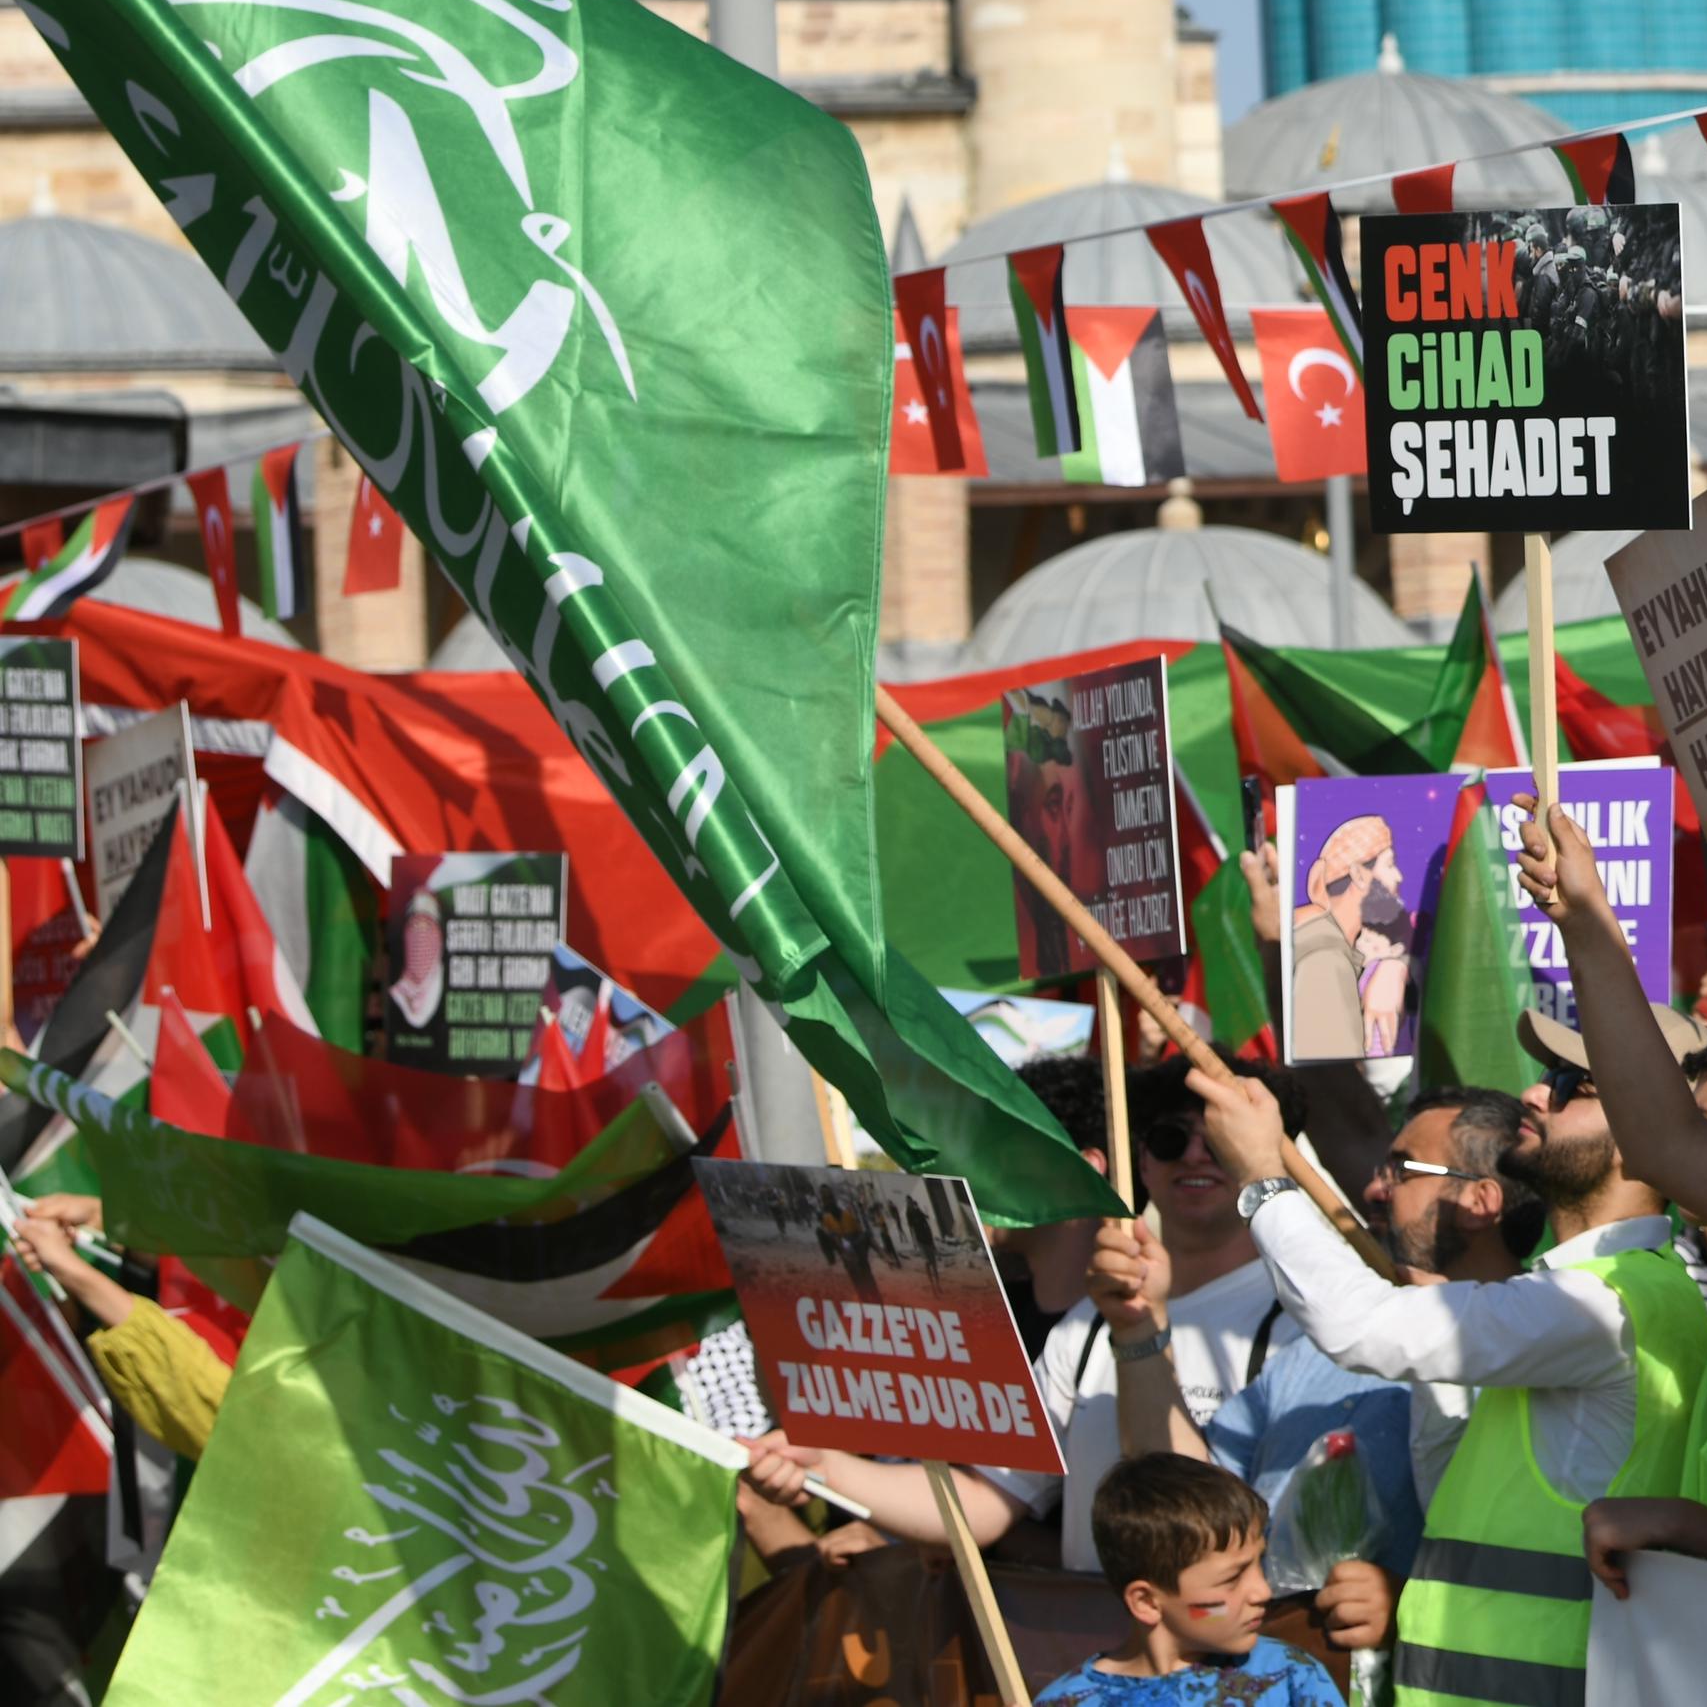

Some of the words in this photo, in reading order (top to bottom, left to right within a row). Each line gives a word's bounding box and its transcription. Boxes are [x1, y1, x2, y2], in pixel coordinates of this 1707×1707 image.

[1384, 240, 1519, 322] CENK
[1387, 329, 1545, 411] CİHAD
[1390, 416, 1616, 515] ŞEHADET
[1632, 597, 1666, 658] EY
[1073, 686, 1104, 731] ALLAH
[1144, 730, 1160, 769] VE
[796, 1296, 972, 1363] GAZZE'DE
[777, 1360, 904, 1423] ZULME
[898, 1372, 985, 1432] DUR
[979, 1381, 1036, 1437] DE
